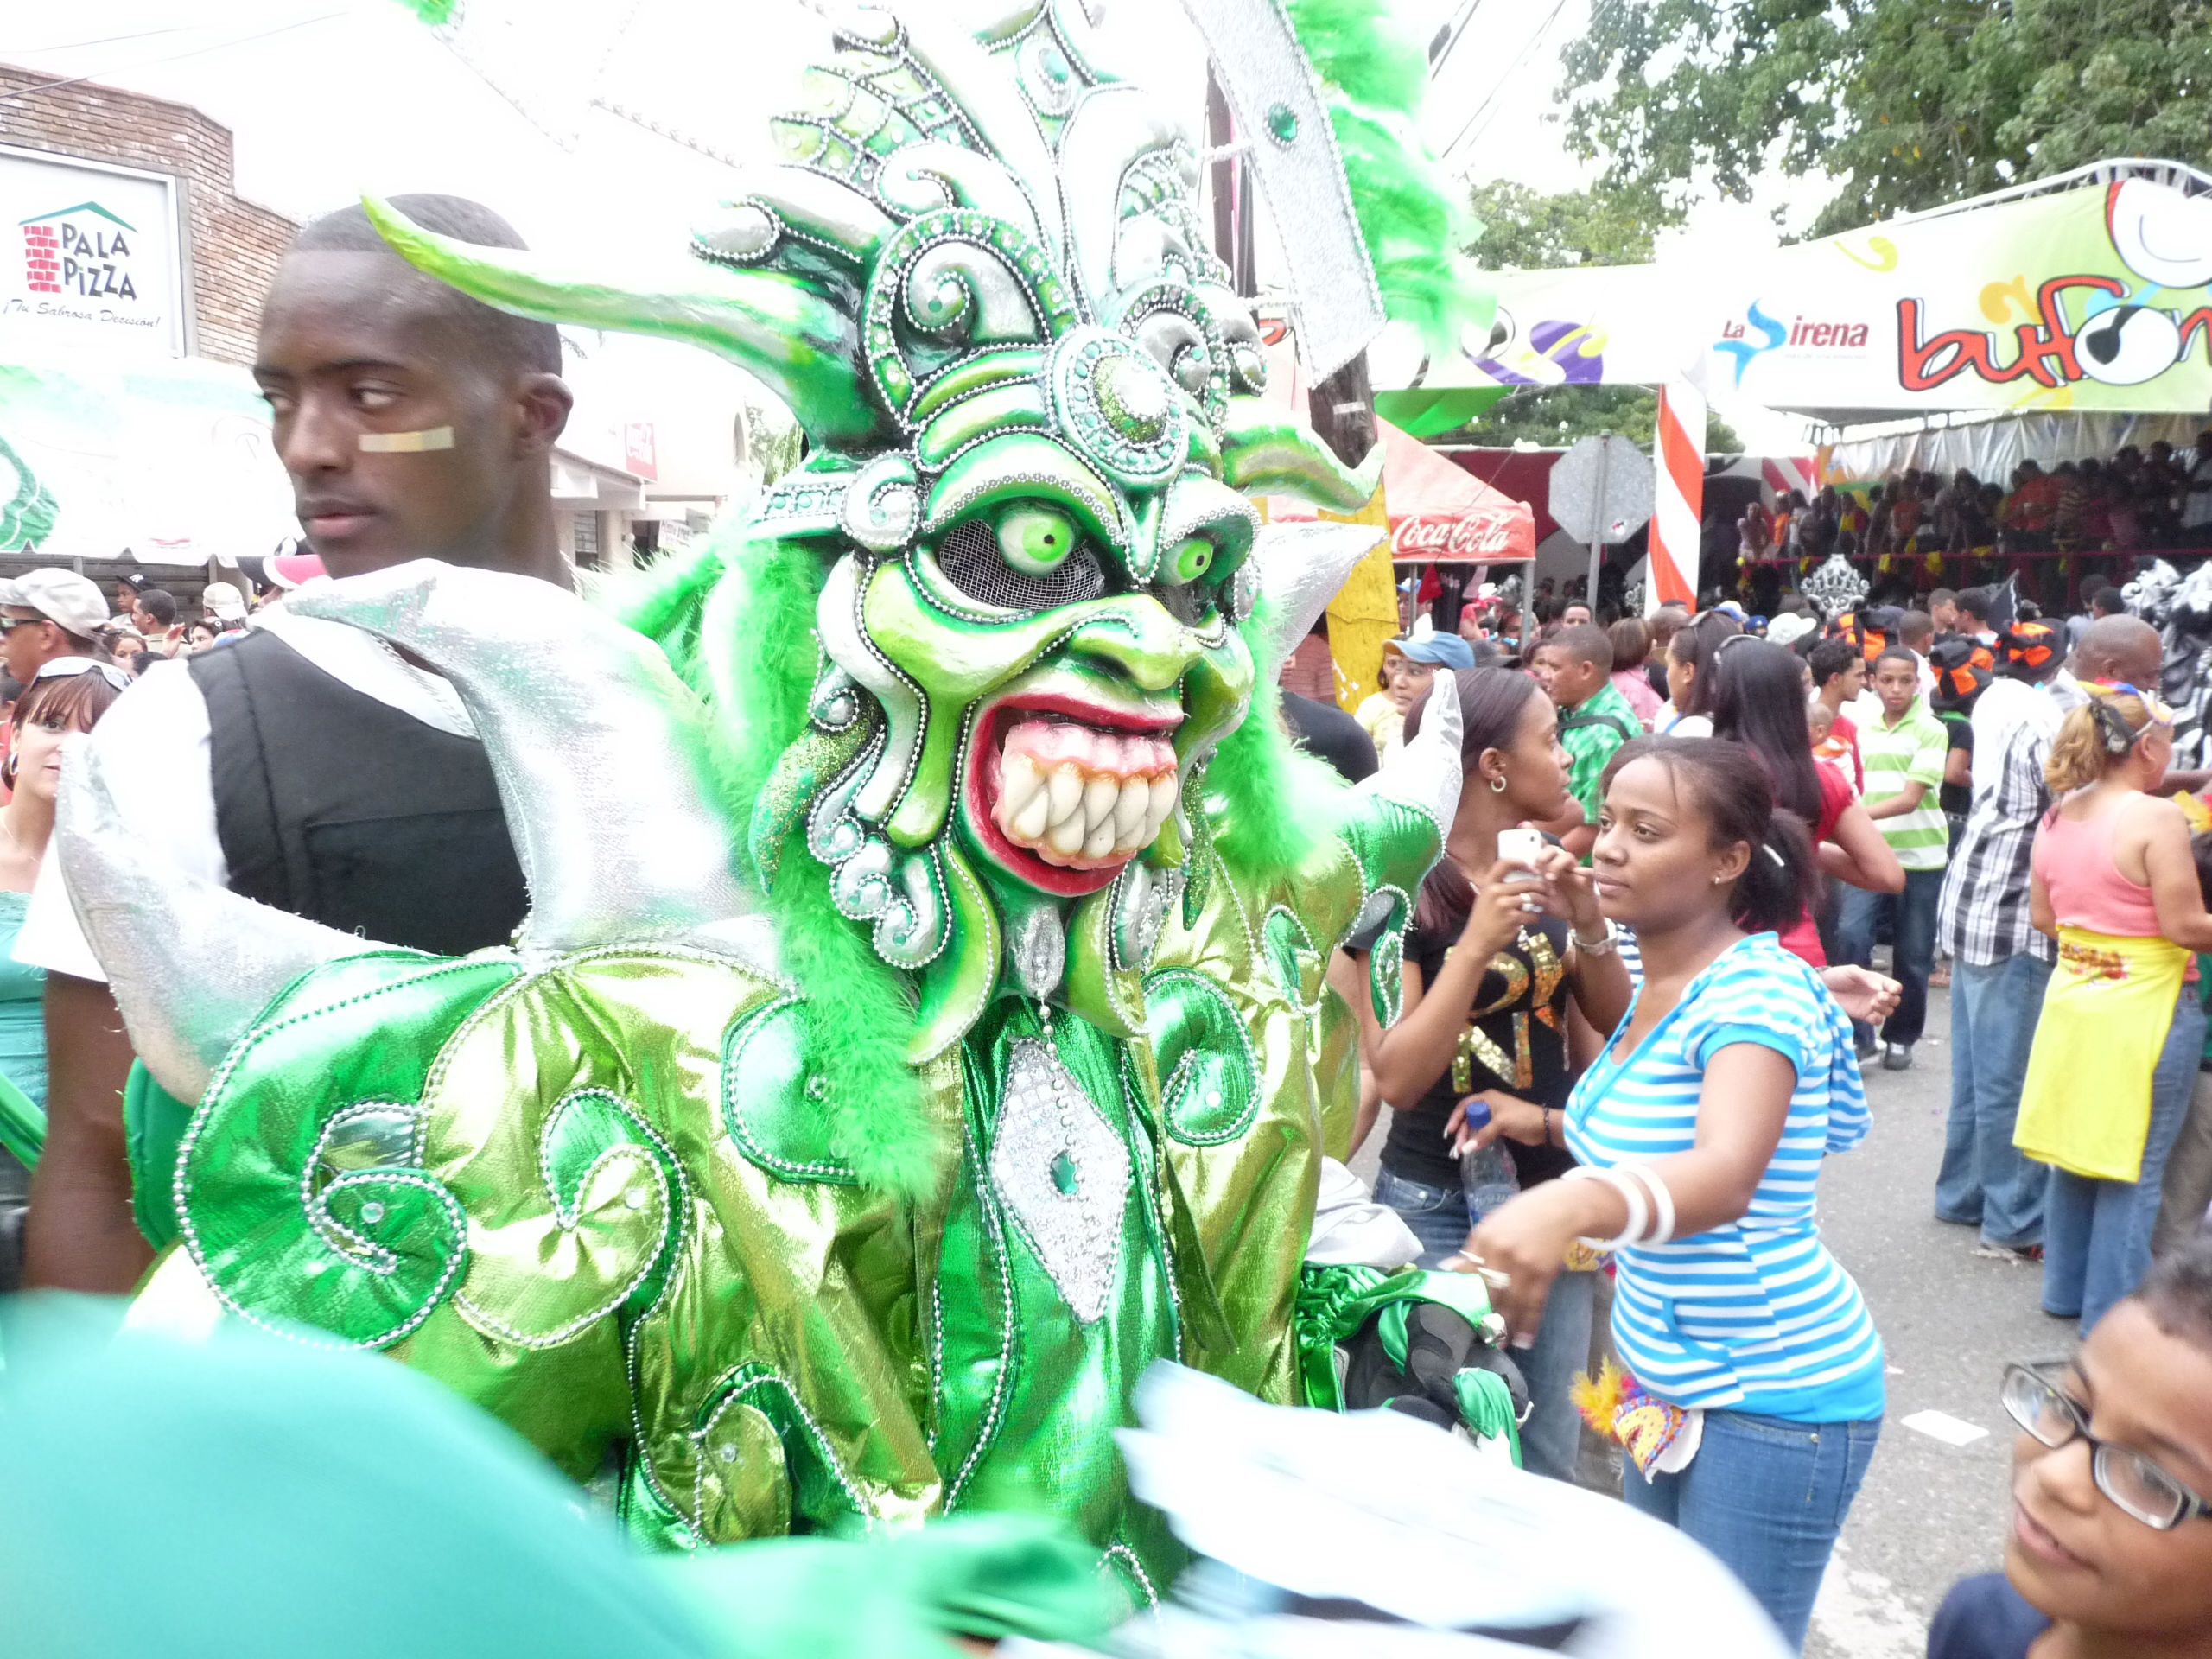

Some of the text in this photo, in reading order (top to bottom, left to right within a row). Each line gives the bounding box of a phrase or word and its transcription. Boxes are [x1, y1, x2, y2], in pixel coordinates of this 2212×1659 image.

[61, 222, 131, 258] PALA
[36, 302, 93, 321] Sabrosa
[1722, 319, 1745, 339] La
